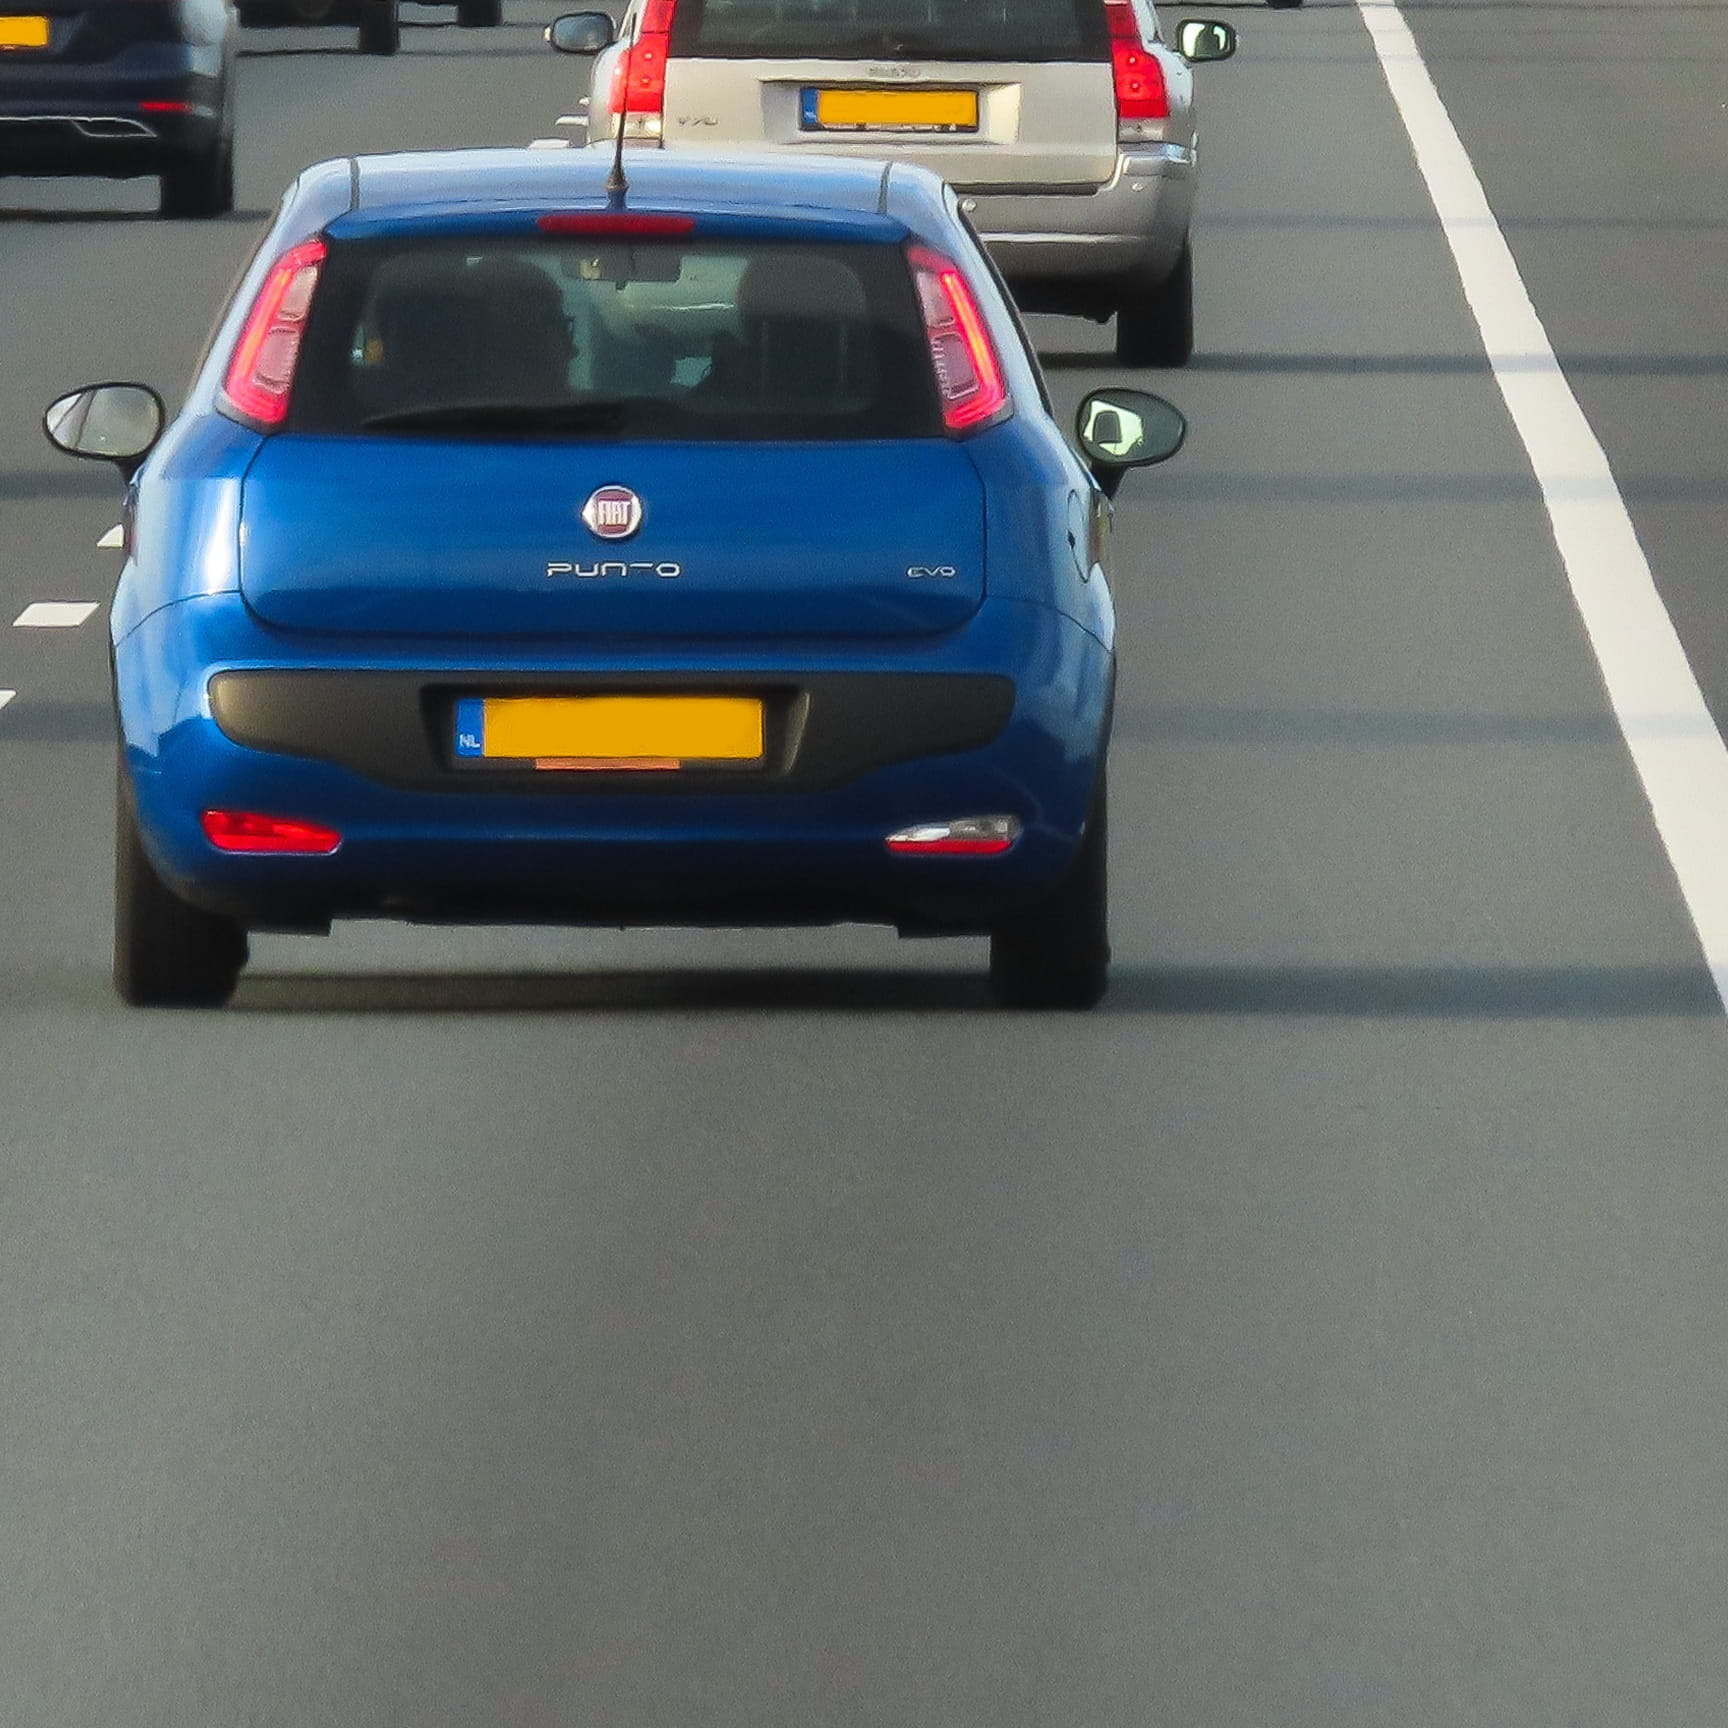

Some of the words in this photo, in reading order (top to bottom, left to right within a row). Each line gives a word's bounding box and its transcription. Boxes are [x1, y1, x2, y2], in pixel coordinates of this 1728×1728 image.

[597, 499, 633, 526] FIAT
[546, 561, 682, 578] PUNTO
[906, 565, 957, 578] EVO
[459, 733, 481, 749] NL
